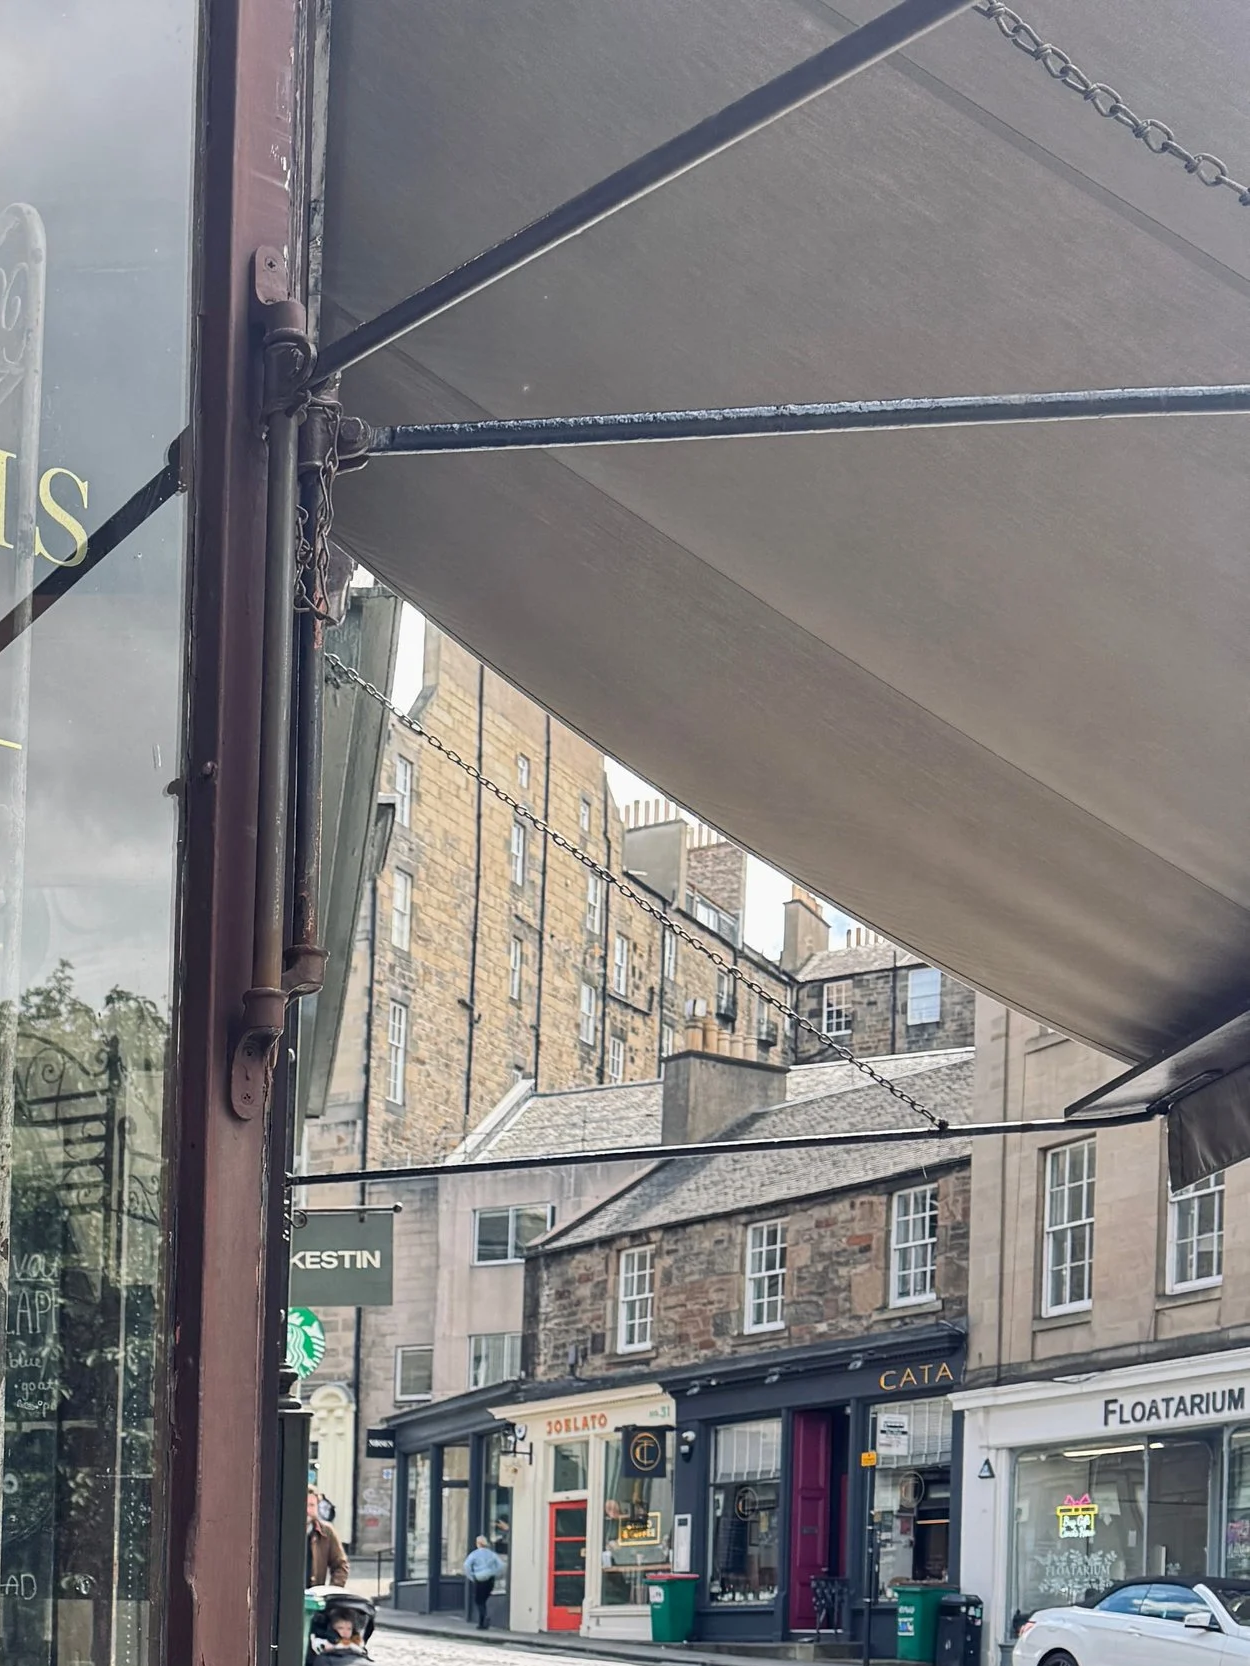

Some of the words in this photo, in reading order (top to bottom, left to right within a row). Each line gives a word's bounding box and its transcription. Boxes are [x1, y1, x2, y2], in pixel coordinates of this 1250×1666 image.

[290, 1250, 380, 1269] KESTIN
[879, 1362, 954, 1391] CATA
[1104, 1387, 1245, 1427] FLOATARIUM
